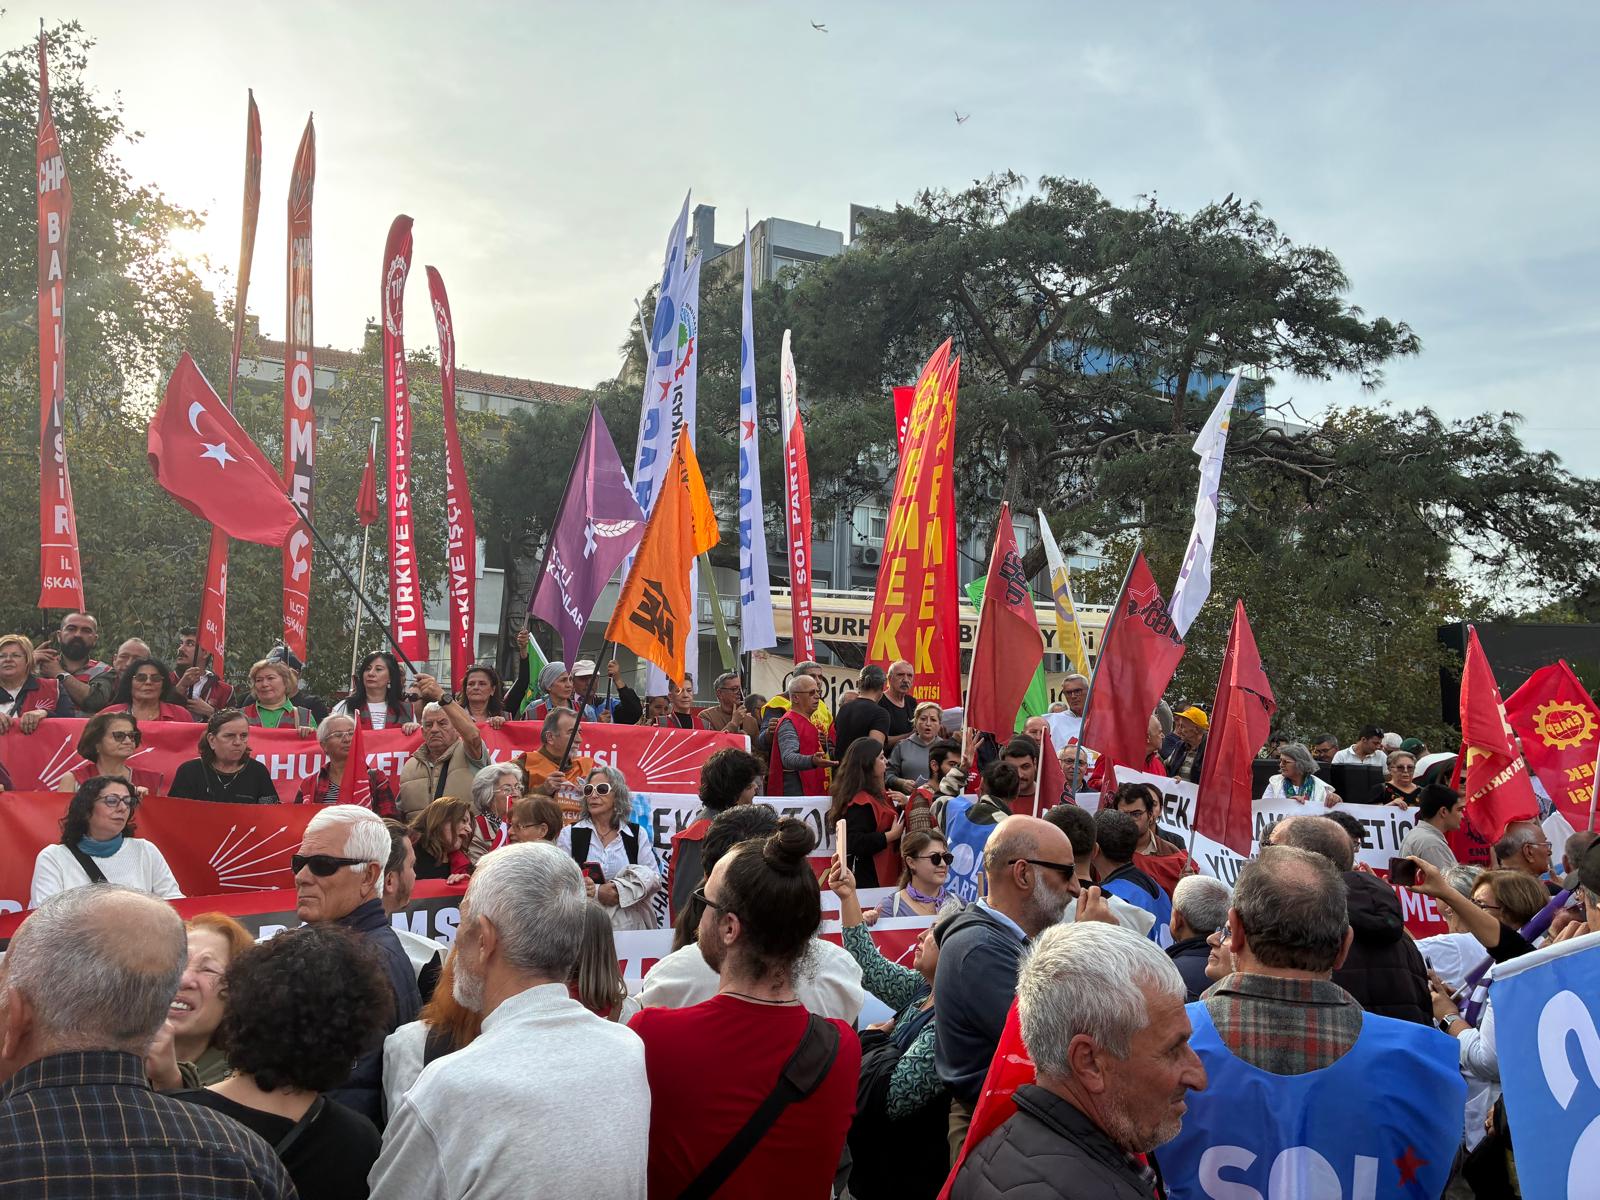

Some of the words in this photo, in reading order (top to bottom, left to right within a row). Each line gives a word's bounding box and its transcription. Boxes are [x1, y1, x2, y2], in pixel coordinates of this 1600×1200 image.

[39, 156, 65, 194] CHP
[393, 523, 417, 644] TÜRKİYE
[794, 531, 807, 585] SOL
[870, 448, 919, 662] EMEK
